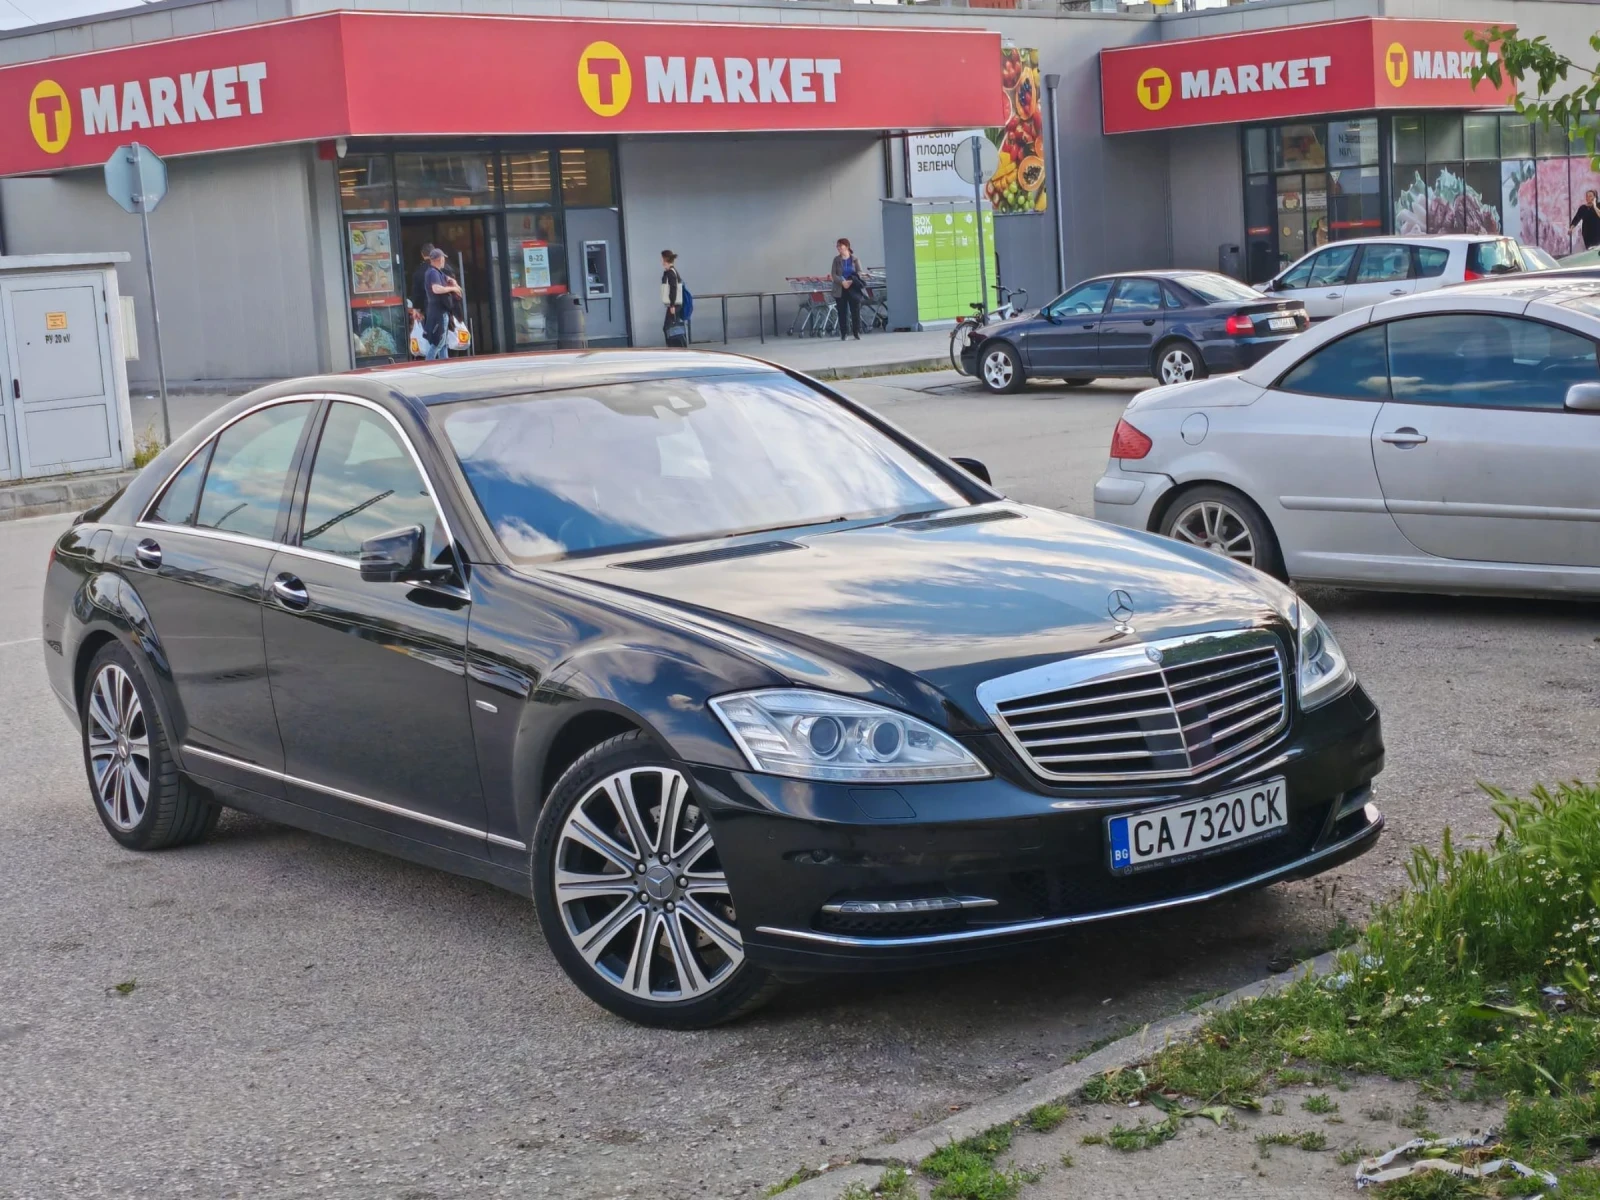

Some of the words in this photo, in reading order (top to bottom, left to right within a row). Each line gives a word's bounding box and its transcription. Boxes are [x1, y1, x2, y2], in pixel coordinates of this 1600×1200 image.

[644, 56, 842, 103] MARKET
[1180, 56, 1331, 100] MARKET
[80, 62, 267, 136] MARKET
[916, 143, 960, 156] ПЛОДОВ
[917, 160, 954, 172] ЗЕЛЕНЧ
[914, 215, 931, 226] BOX
[914, 225, 933, 236] NOW
[55, 334, 62, 344] 20
[1133, 815, 1175, 857] CA
[1180, 797, 1246, 848] 7320
[1250, 786, 1283, 828] CK
[1114, 849, 1129, 861] BG
